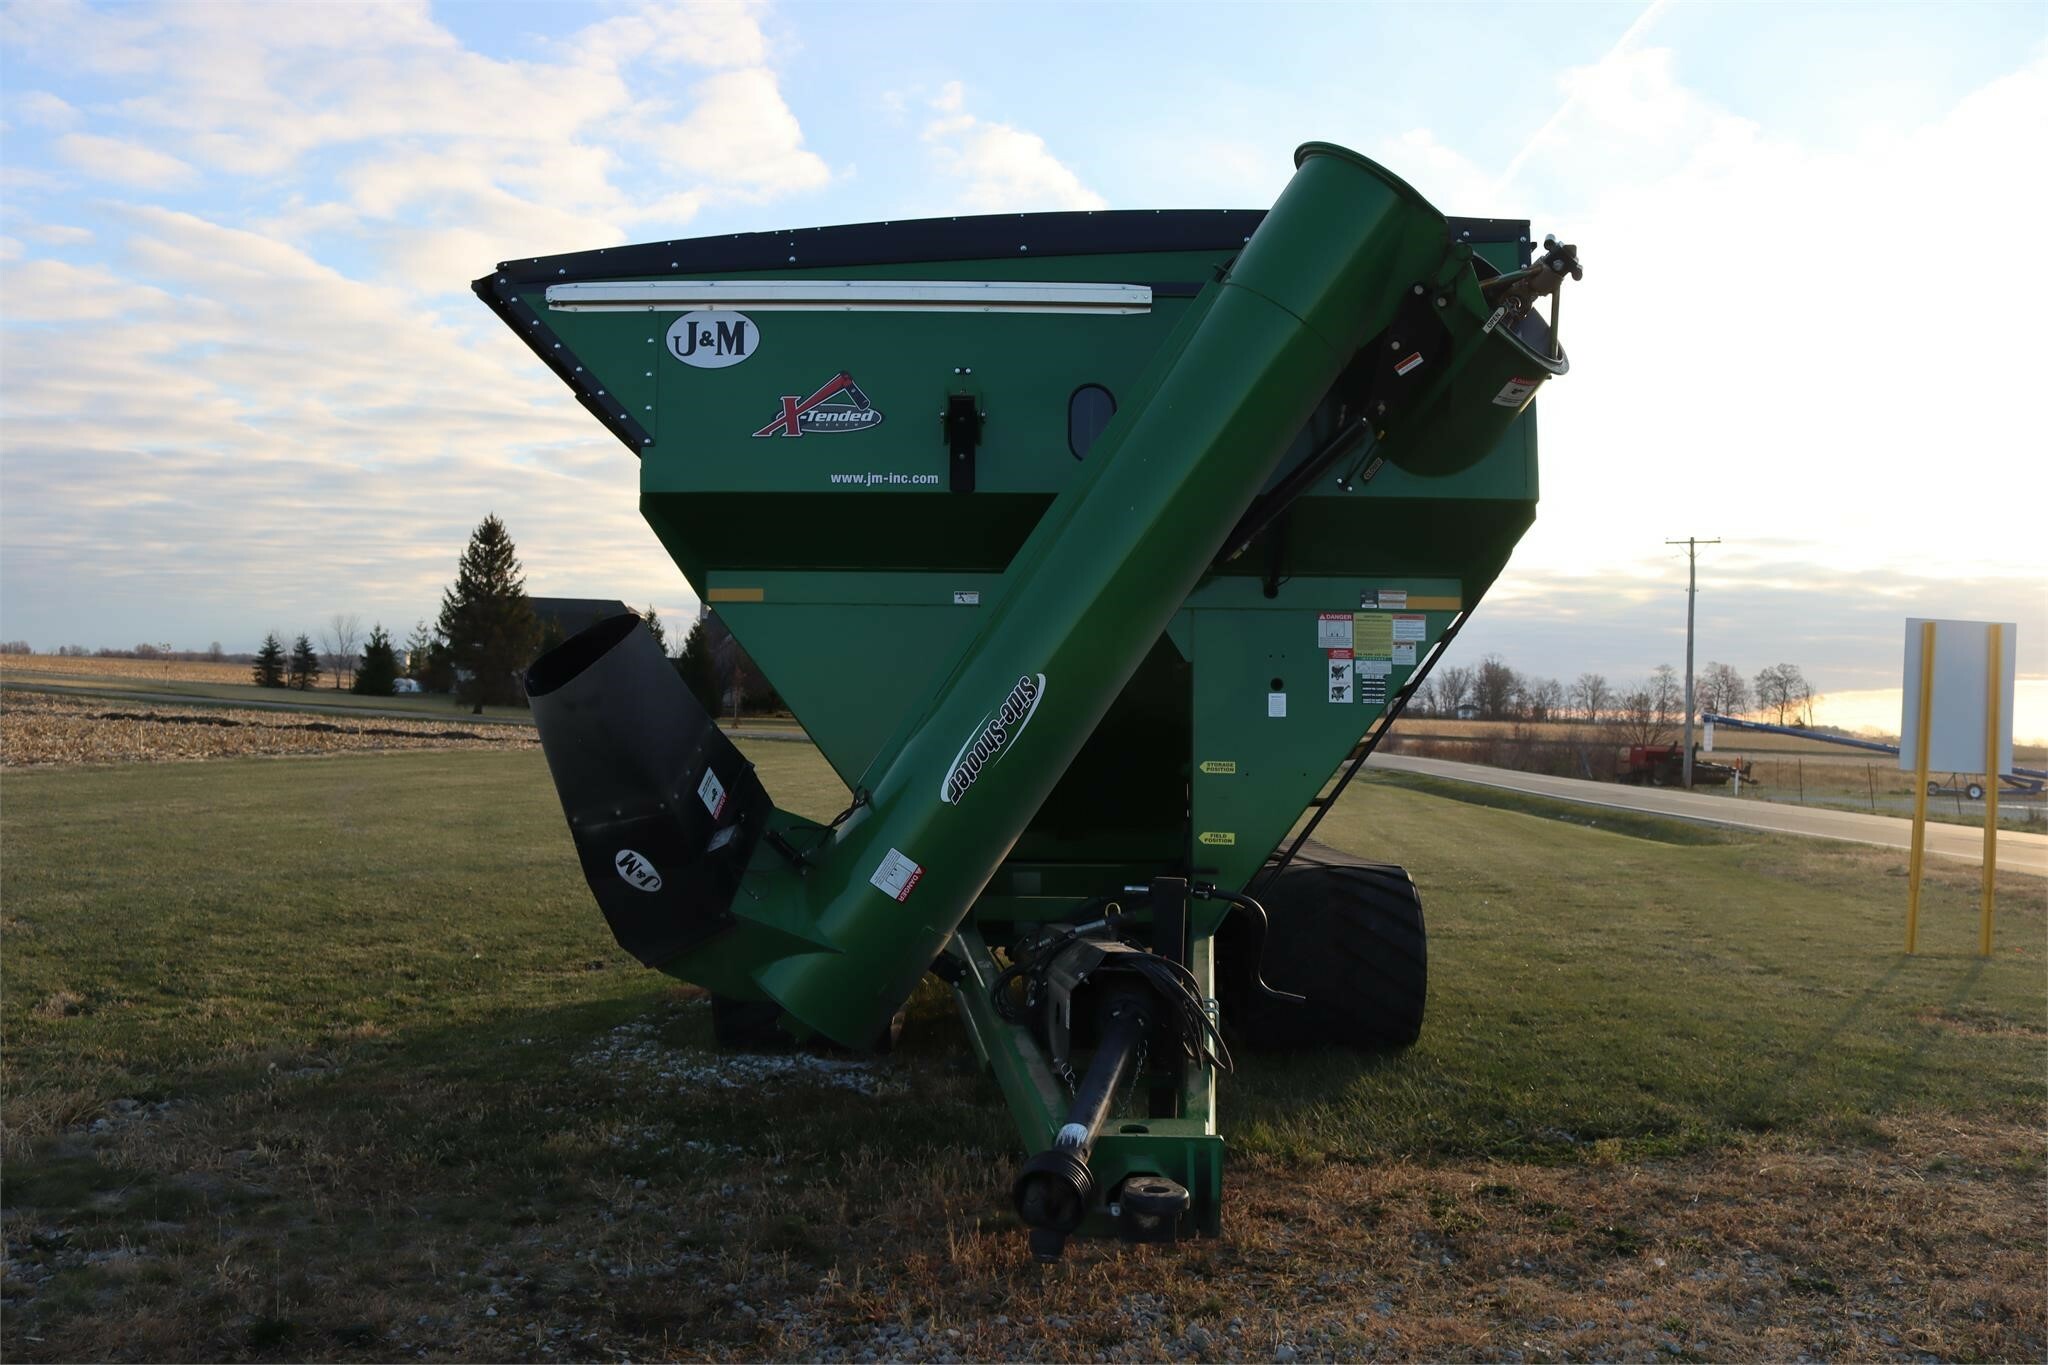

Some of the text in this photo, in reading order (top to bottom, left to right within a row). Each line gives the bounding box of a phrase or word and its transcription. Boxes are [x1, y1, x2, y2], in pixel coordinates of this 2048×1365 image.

[673, 320, 747, 357] J&M
[752, 392, 875, 437] X-Tended
[830, 472, 939, 487] www.jm-inc.com
[948, 675, 1038, 806] Side-Shooter
[617, 851, 661, 889] J&M
[898, 874, 919, 902] DANGER
